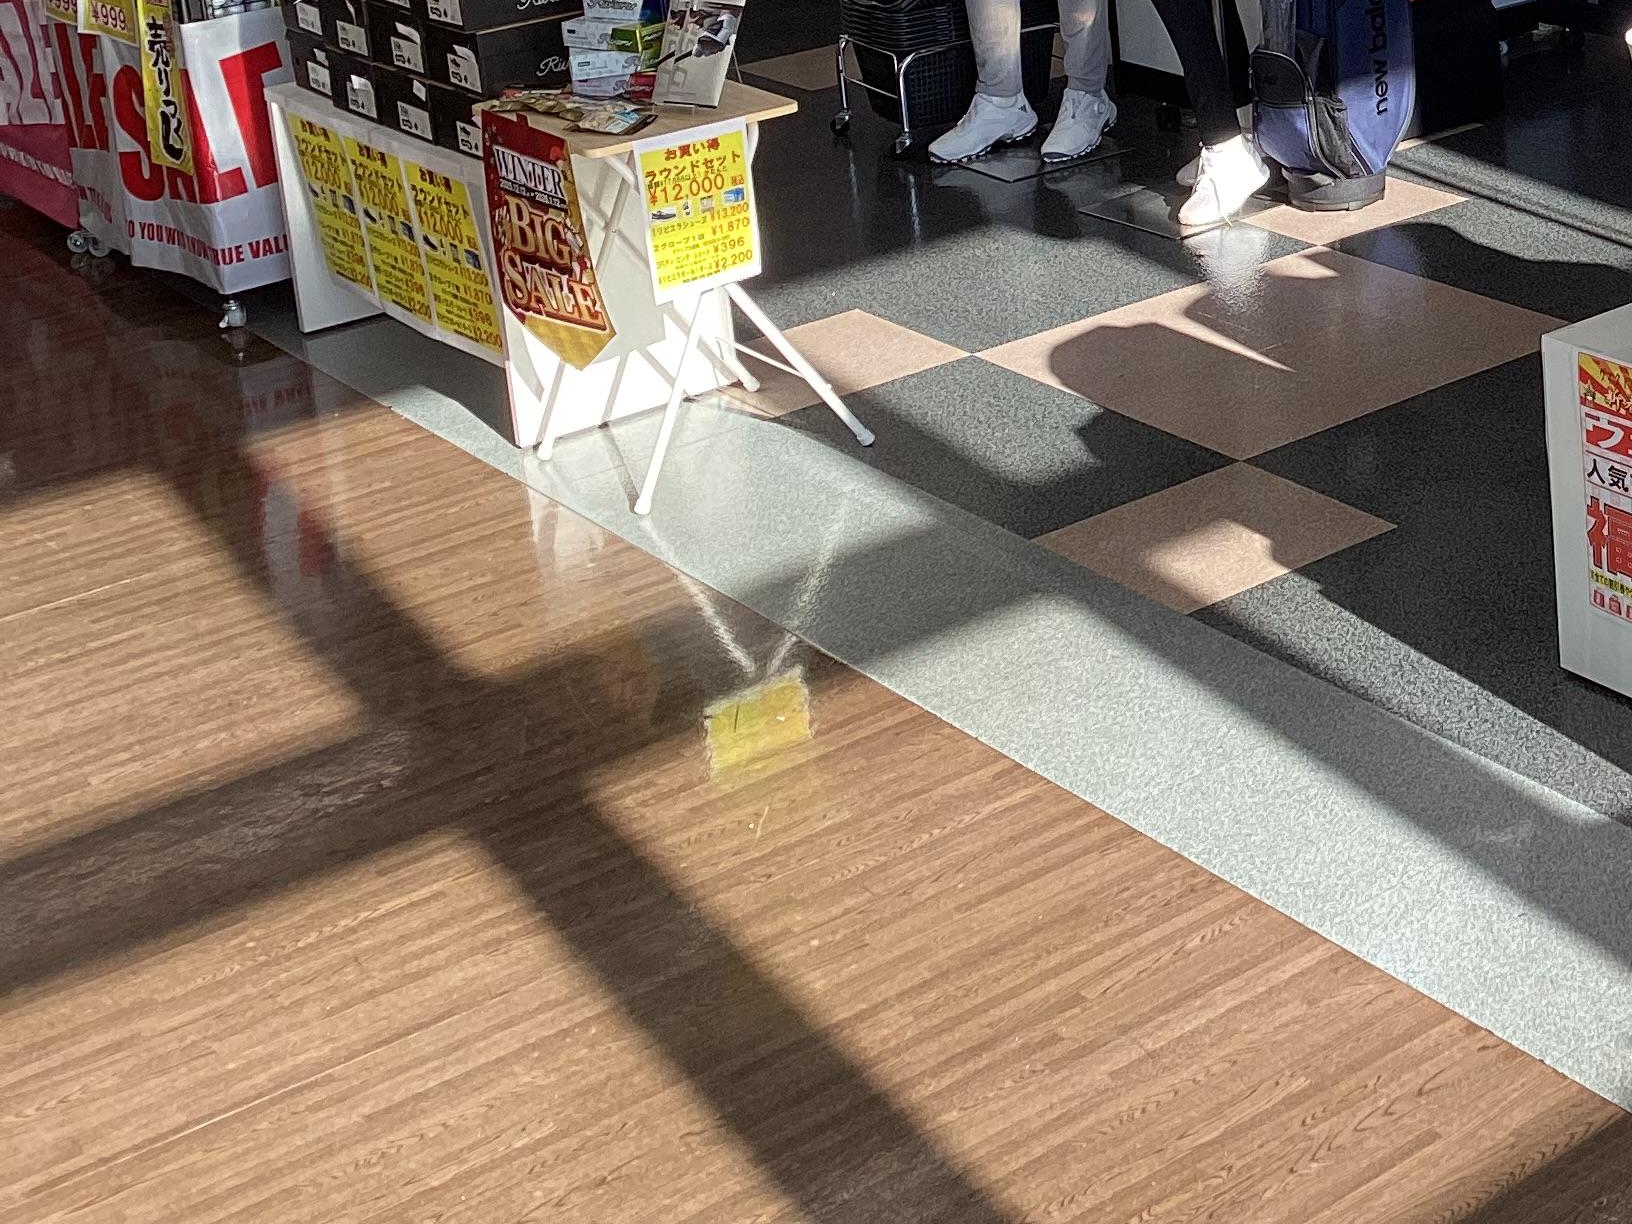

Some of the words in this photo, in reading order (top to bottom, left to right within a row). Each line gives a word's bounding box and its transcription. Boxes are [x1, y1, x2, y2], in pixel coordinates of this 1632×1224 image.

[91, 4, 128, 32] ¥999
[1374, 60, 1389, 116] new
[664, 138, 721, 162] お買い得
[494, 147, 567, 200] WINTER
[645, 150, 741, 183] ラウンドセット
[649, 173, 725, 206] ¥12,000
[710, 202, 750, 221] ¥13,200
[139, 223, 163, 241] YOU
[505, 195, 573, 270] BIG
[711, 217, 750, 236] ¥1,870
[713, 237, 745, 254] ¥396
[714, 250, 753, 271] ¥2,200
[503, 250, 607, 331] SALE
